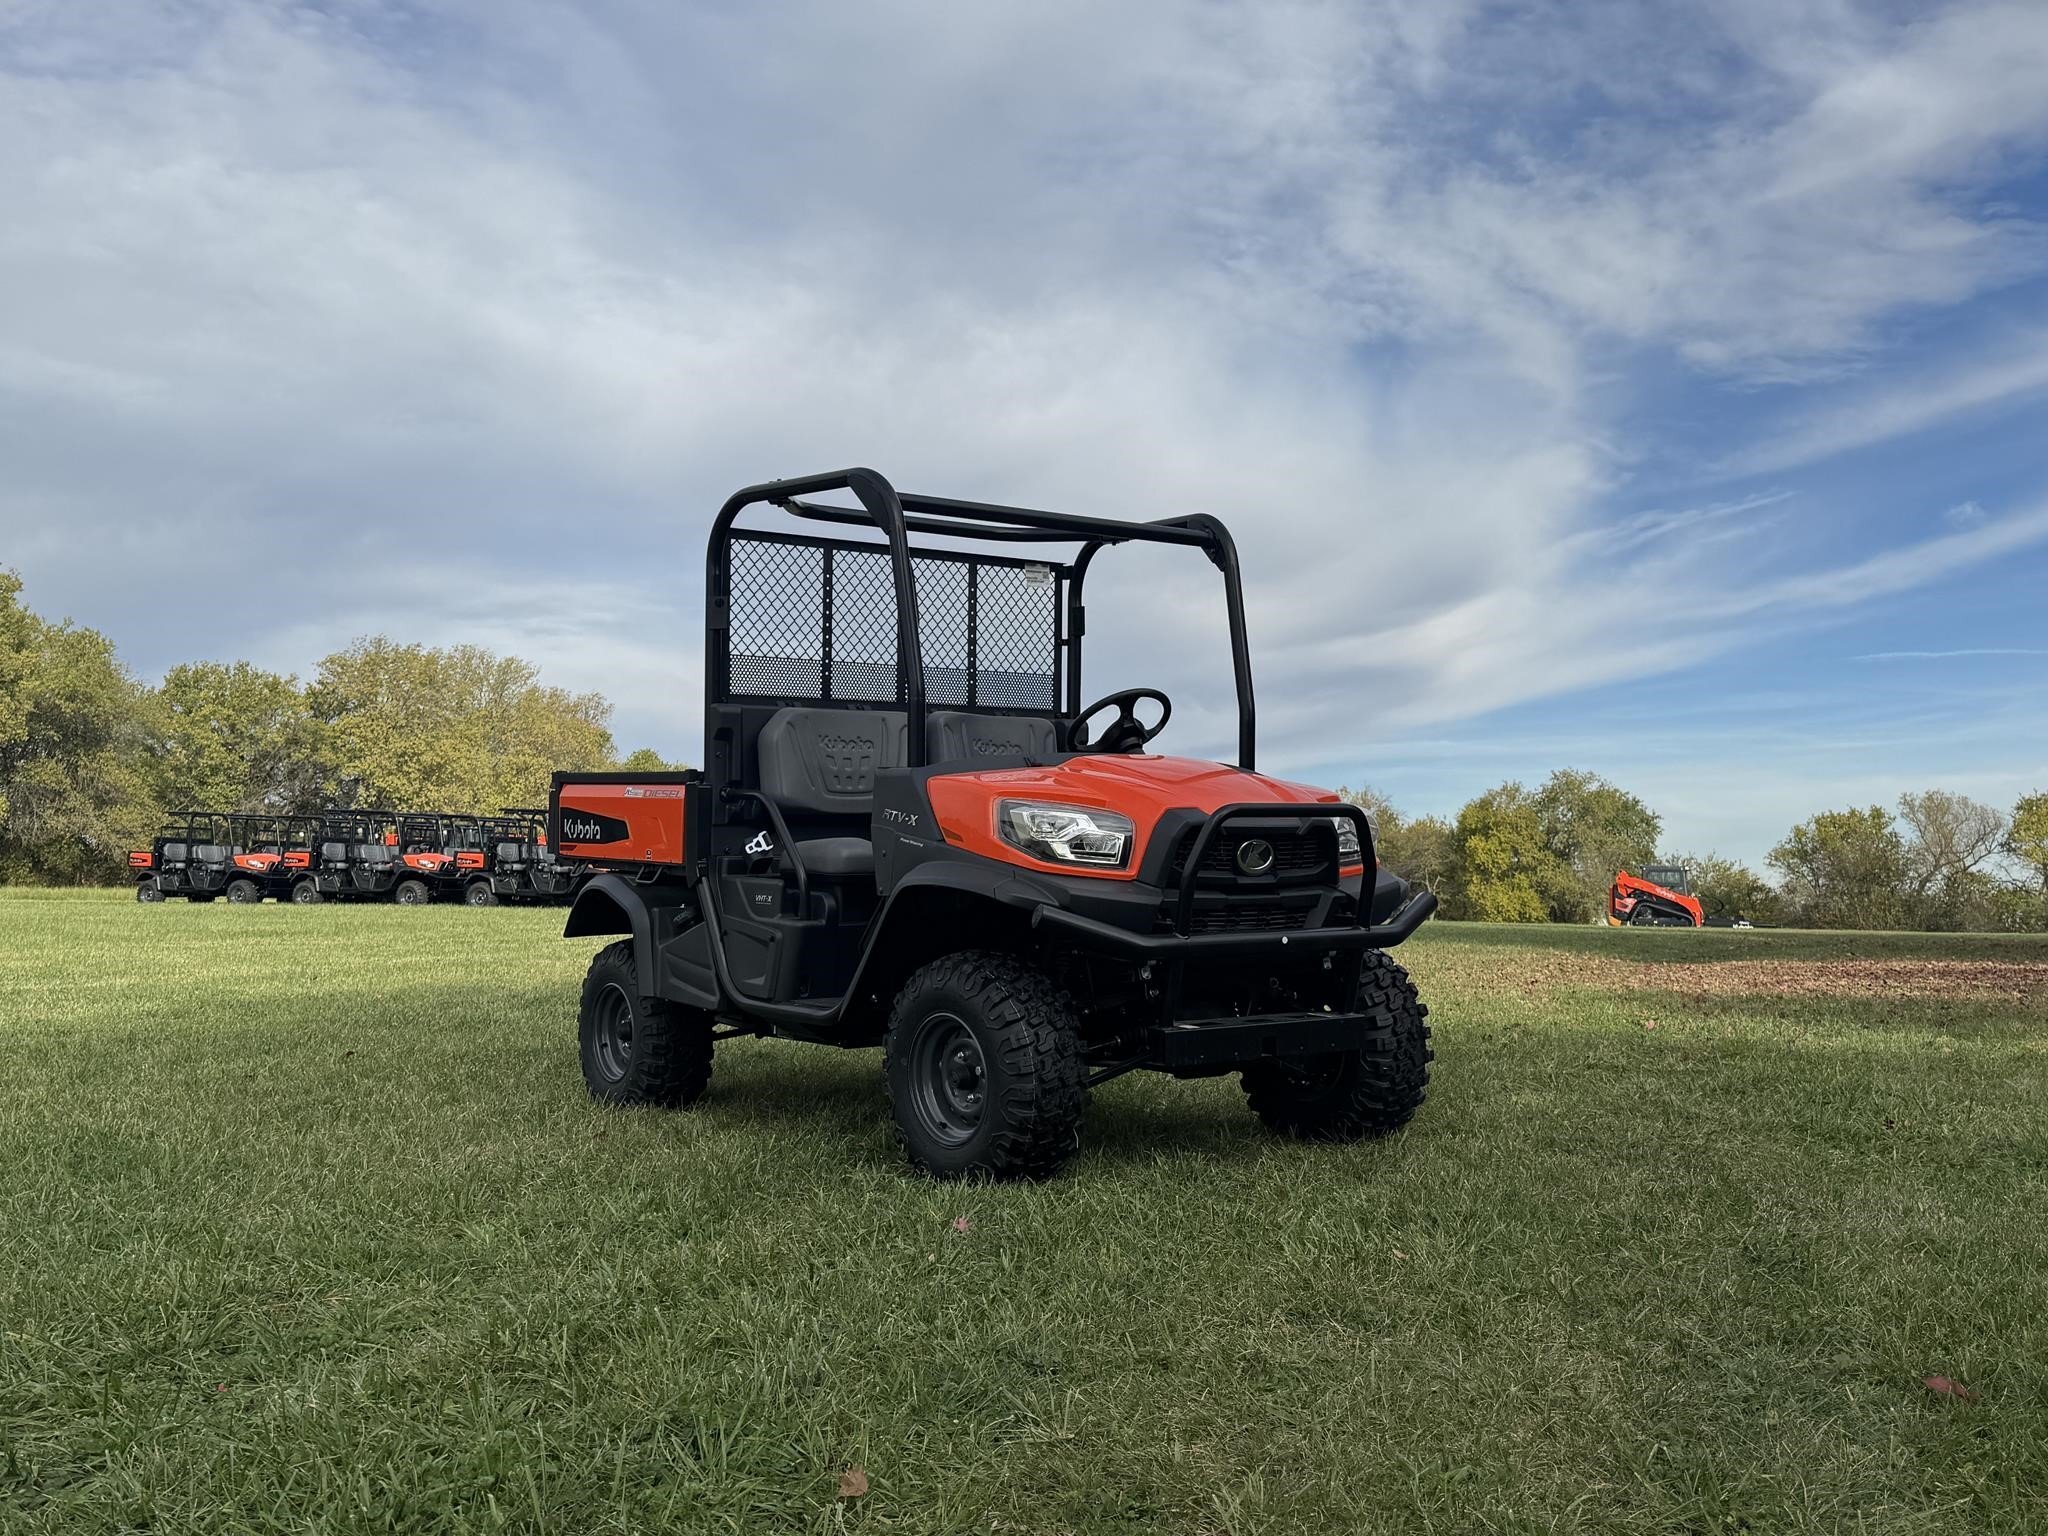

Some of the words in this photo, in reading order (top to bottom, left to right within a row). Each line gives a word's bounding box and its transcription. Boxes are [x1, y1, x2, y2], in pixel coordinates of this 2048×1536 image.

[818, 734, 875, 752] Kubota
[973, 738, 1023, 756] Kubota
[882, 808, 919, 826] RTV-X
[564, 818, 601, 840] Kubota
